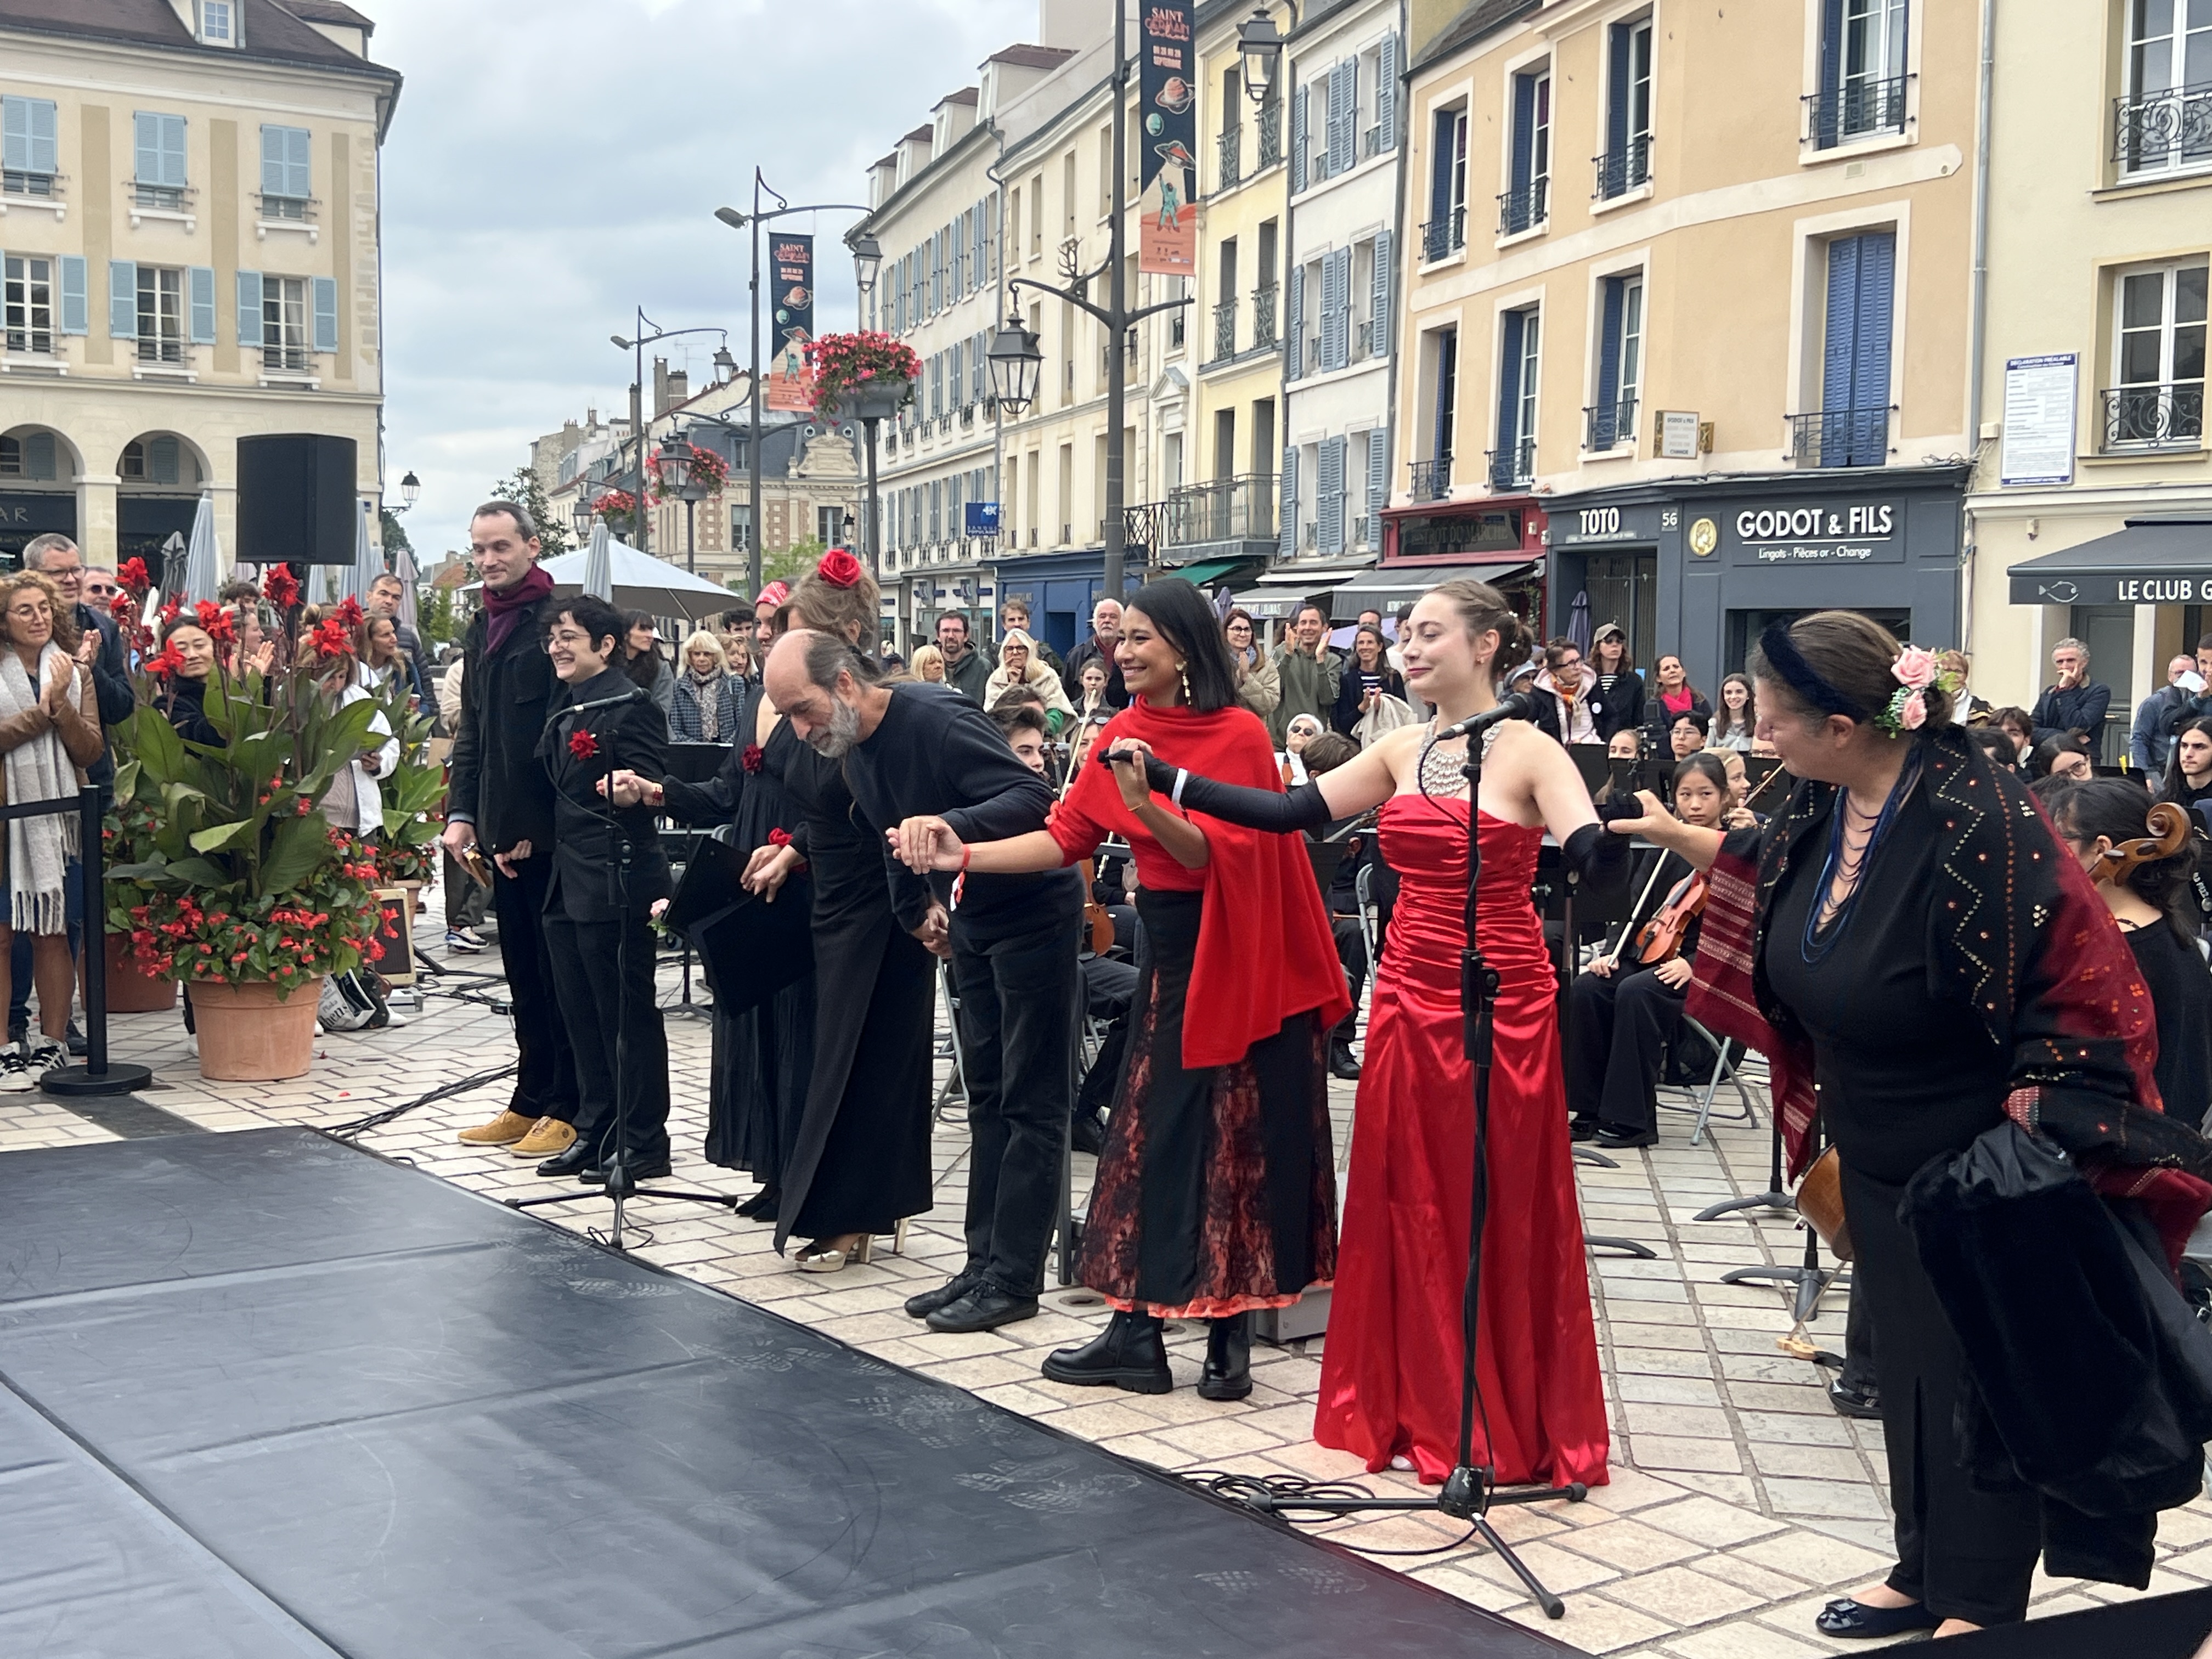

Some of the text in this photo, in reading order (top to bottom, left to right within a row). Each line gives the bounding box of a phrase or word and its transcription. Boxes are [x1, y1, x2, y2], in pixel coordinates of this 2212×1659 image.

[1152, 7, 1183, 22] SAINT
[780, 243, 804, 252] SAINT
[1579, 507, 1620, 534] TOTO
[1662, 512, 1678, 527] 56
[1736, 505, 1892, 538] GODOT & FILS
[1758, 548, 1787, 562] Lingots
[1819, 549, 1829, 557] or
[1836, 545, 1872, 560] Change
[2118, 580, 2139, 601] LE
[2142, 579, 2192, 601] CLUB
